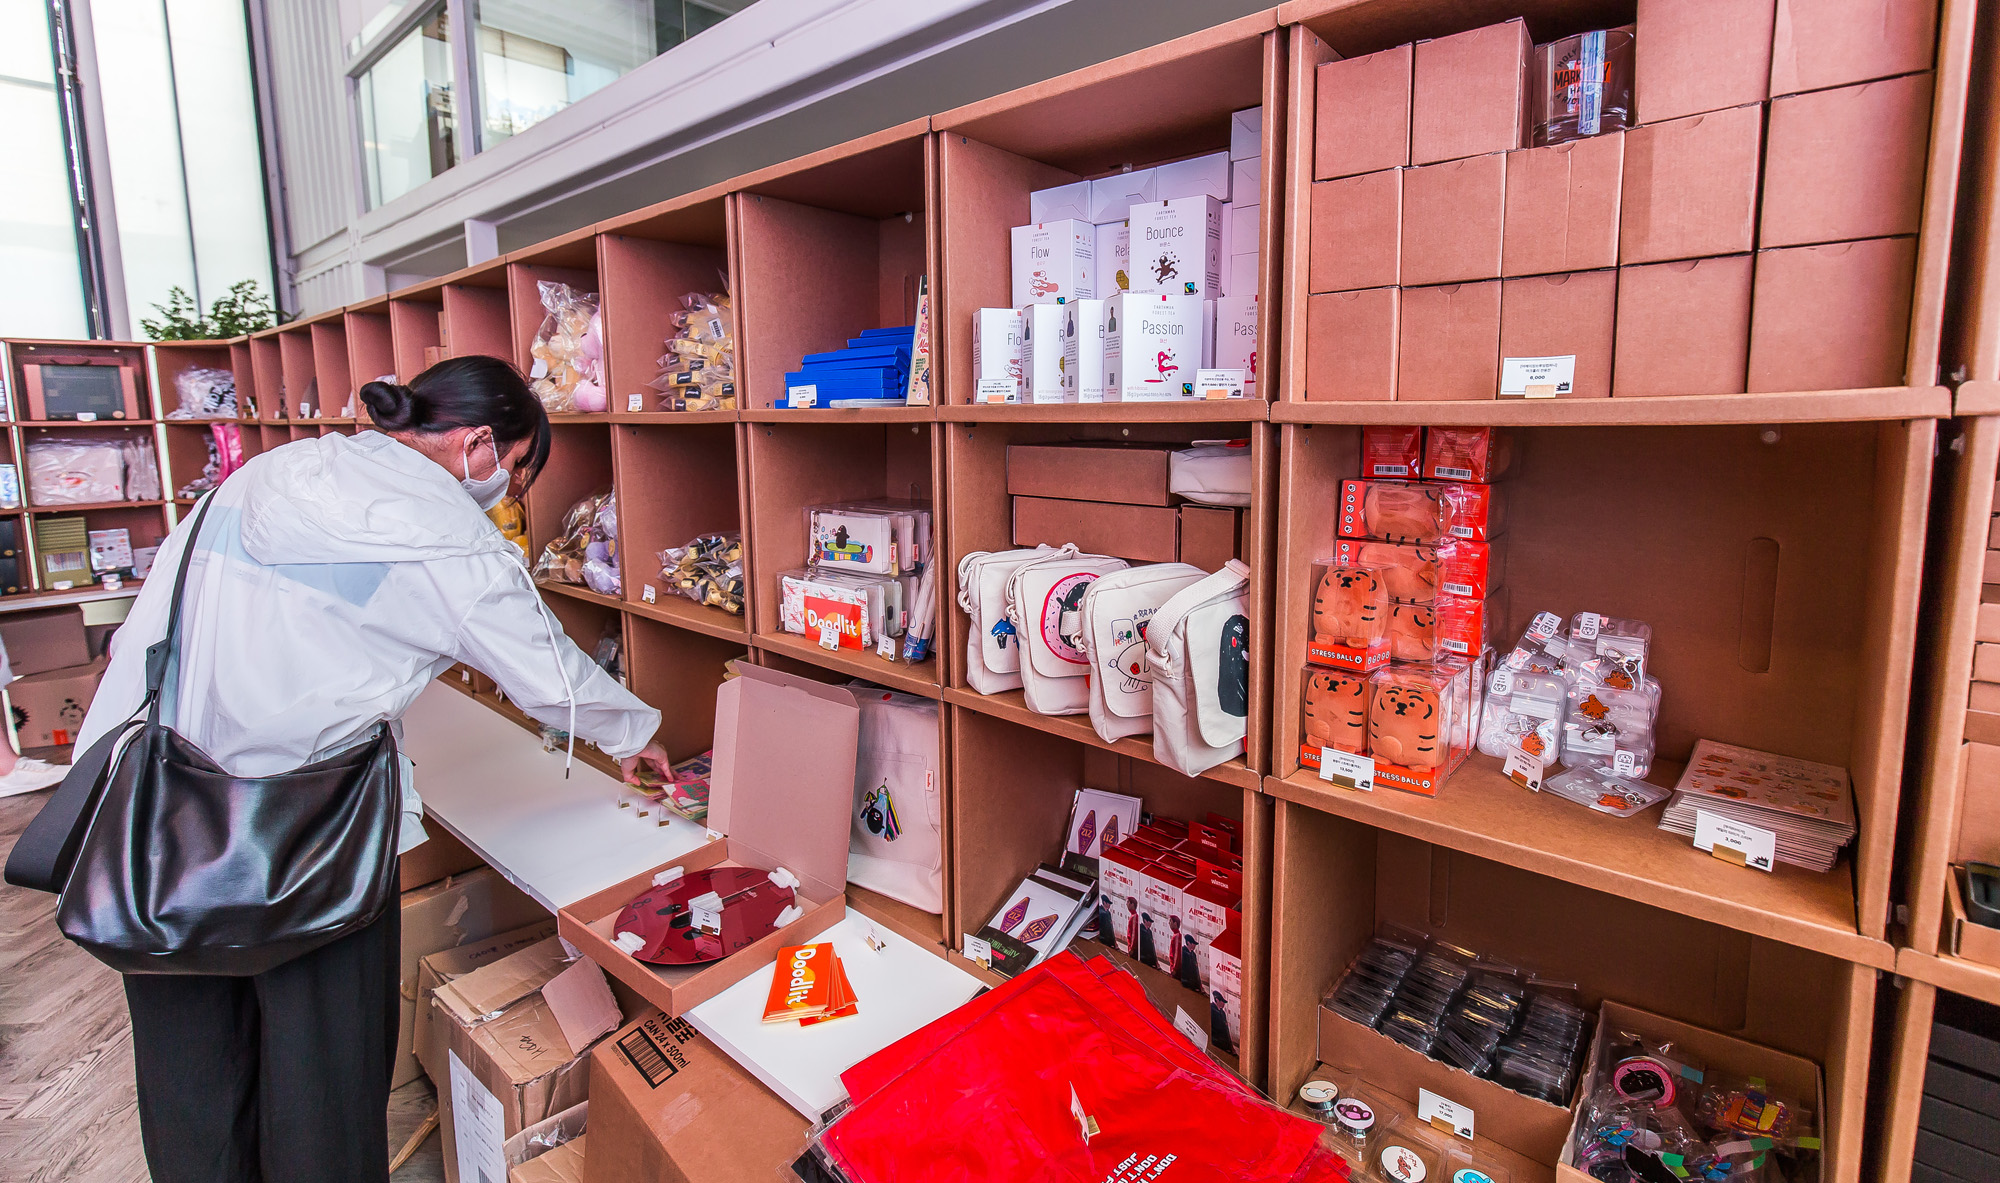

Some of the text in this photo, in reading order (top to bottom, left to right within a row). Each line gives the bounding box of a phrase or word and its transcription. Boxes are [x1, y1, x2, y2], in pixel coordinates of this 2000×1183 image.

[1554, 63, 1610, 90] MARKY
[1146, 226, 1184, 240] Bounce
[1031, 246, 1050, 259] Flow
[1142, 320, 1184, 336] Passion
[1234, 322, 1257, 336] Pass
[1007, 333, 1021, 346] Flo
[807, 609, 858, 637] Doodlit
[1311, 648, 1354, 662] STRESS BALL
[1304, 752, 1322, 762] STRE
[1373, 770, 1421, 786] STRESS BALL
[786, 948, 817, 1006] Doodlit
[643, 1020, 691, 1068] CAN 24 x 500ml
[1113, 1152, 1138, 1177] JUST
[1126, 1154, 1158, 1181] DON'T
[1146, 1153, 1178, 1180] DON'T
